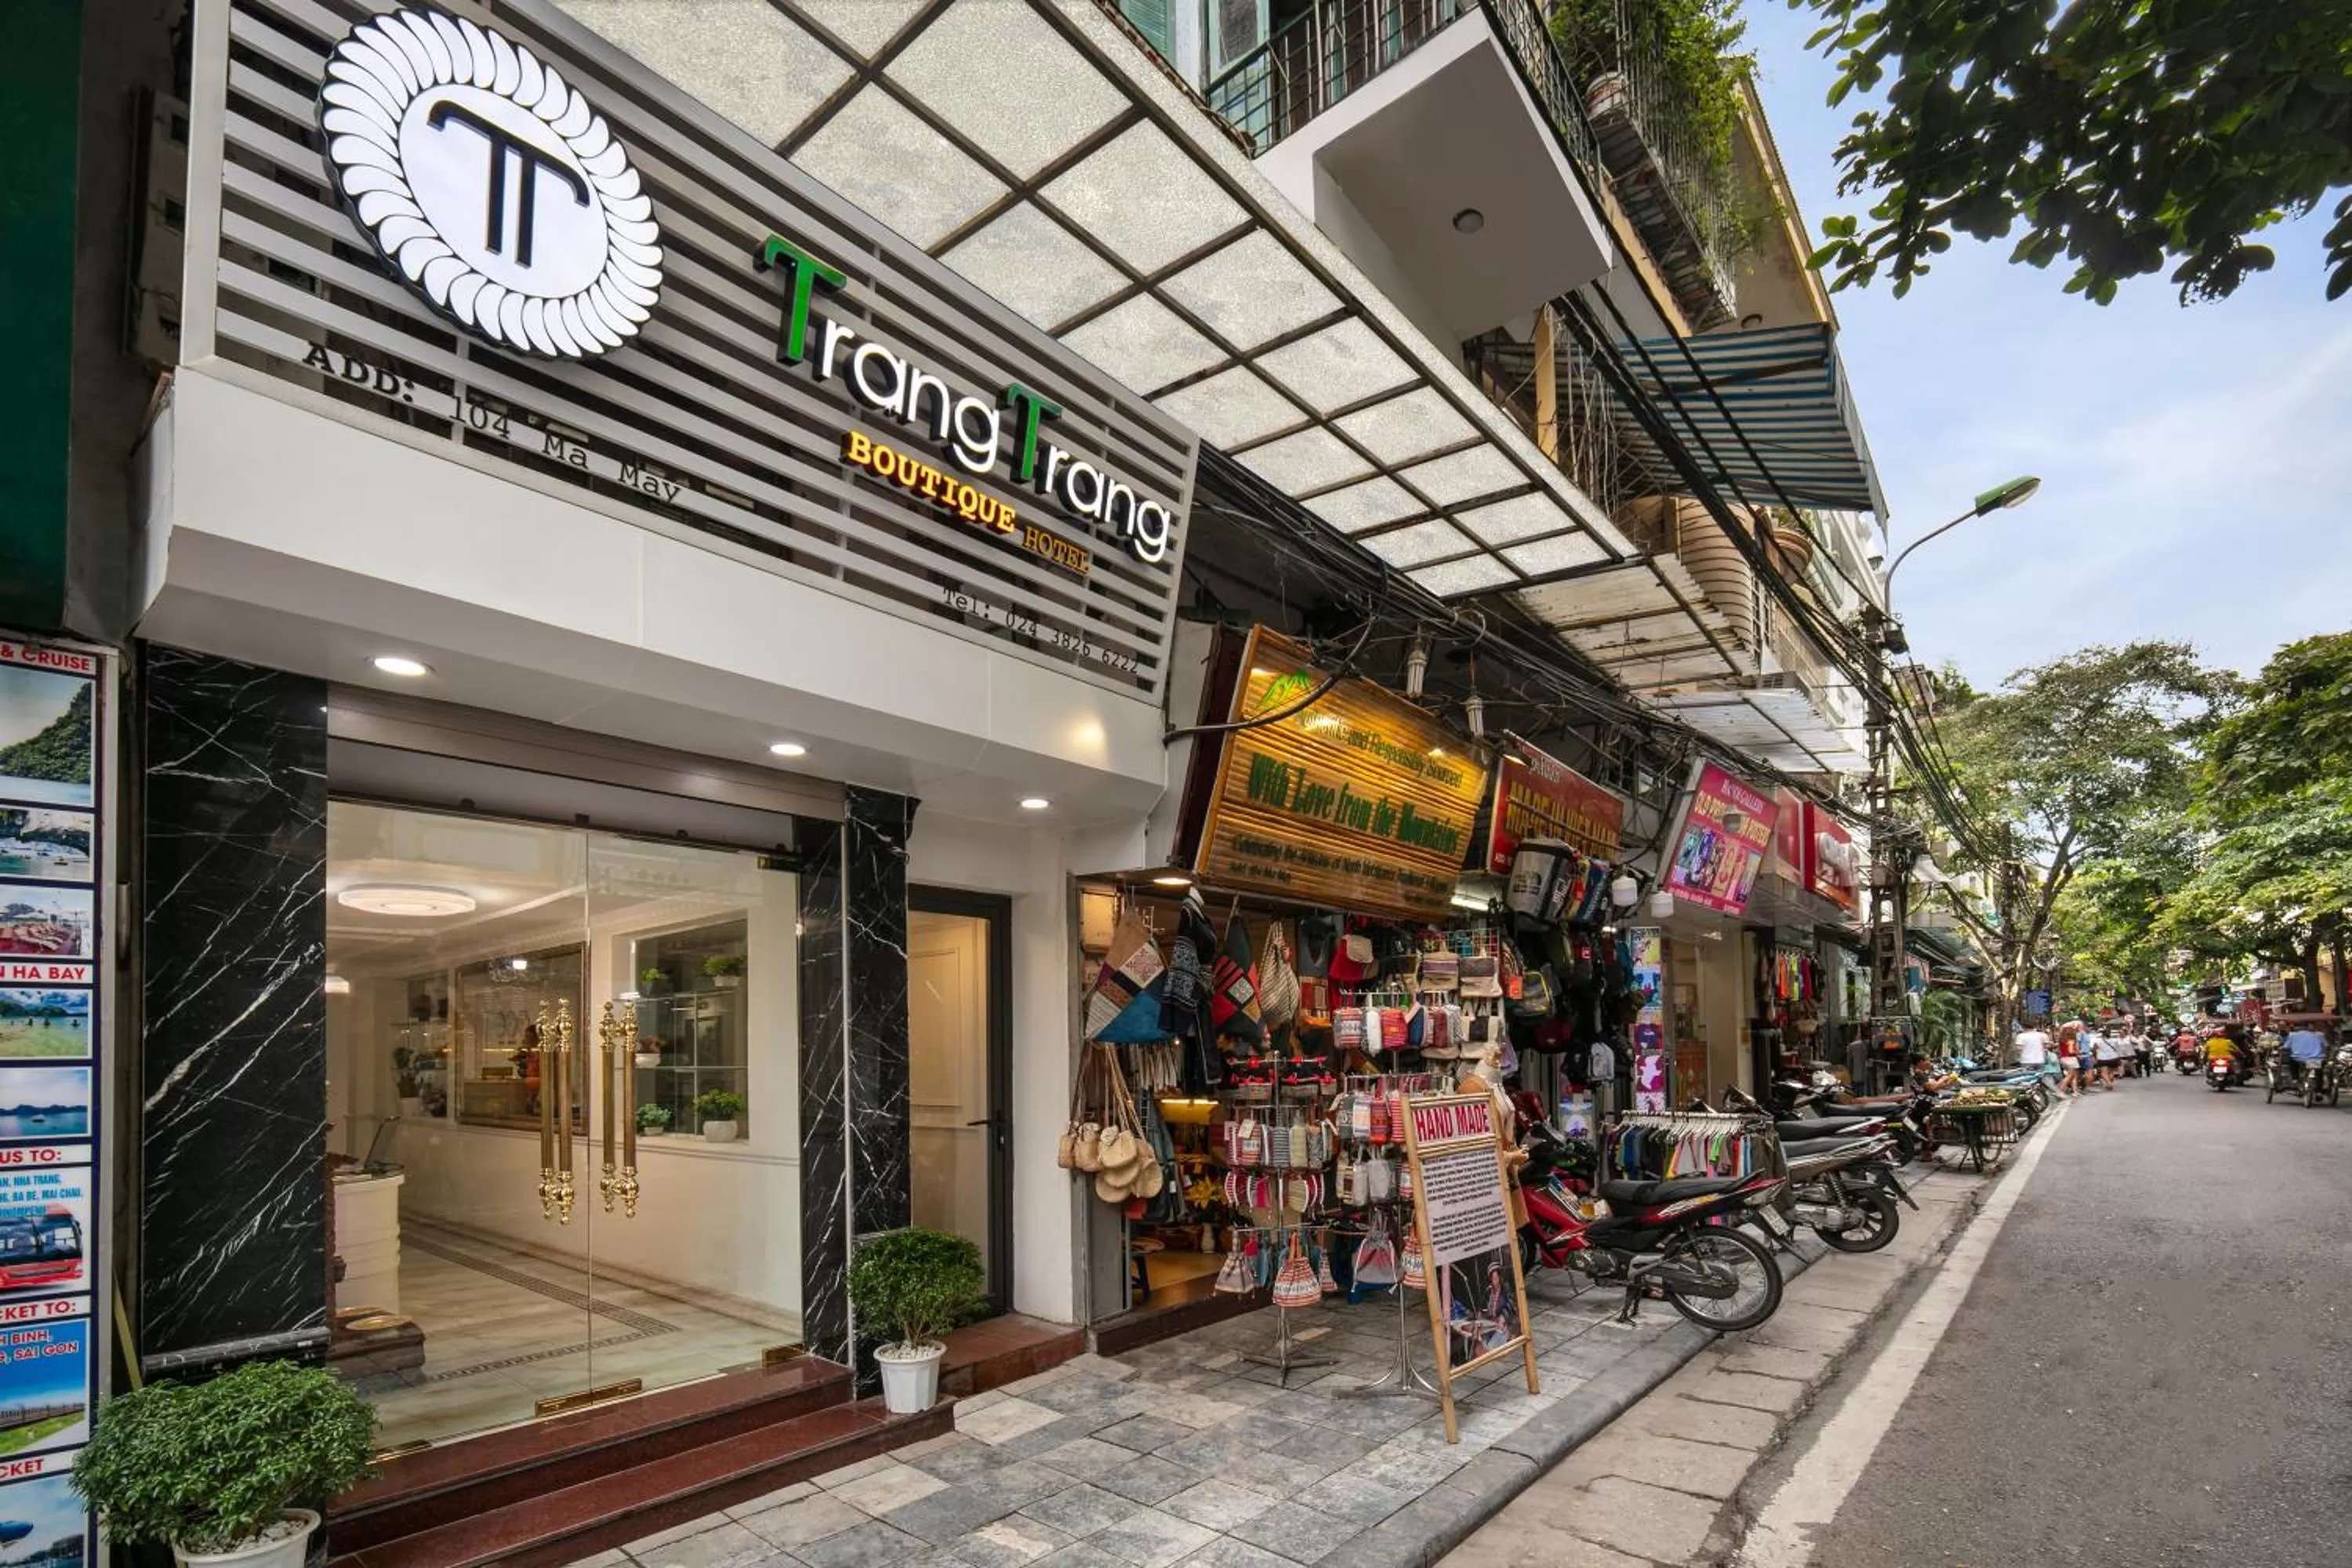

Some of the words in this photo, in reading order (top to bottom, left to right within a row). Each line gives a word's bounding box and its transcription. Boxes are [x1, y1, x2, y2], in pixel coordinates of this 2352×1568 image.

[303, 340, 416, 404] ADD:
[449, 395, 510, 440] 104
[542, 435, 588, 470] Ma
[619, 462, 682, 503] May
[844, 430, 1016, 535] BOUTIQUE
[1023, 525, 1091, 574] HOTEL
[943, 588, 990, 619] Tel:
[1006, 611, 1037, 639] 024
[1051, 629, 1091, 658] 3826
[1102, 648, 1139, 675] 6222
[1, 644, 13, 658] &
[21, 644, 90, 670] CRUISE
[1292, 768, 1335, 820] Love
[1334, 782, 1371, 831] from
[1372, 797, 1396, 837] the
[12, 965, 42, 979] HA
[49, 967, 85, 979] BAY
[1414, 1106, 1454, 1142] HAND
[1456, 1103, 1490, 1137] MADE
[29, 1149, 62, 1163] TO:
[0, 1304, 38, 1320] KET
[44, 1301, 76, 1316] TO:
[15, 1346, 38, 1359] SAI
[43, 1341, 78, 1356] GON
